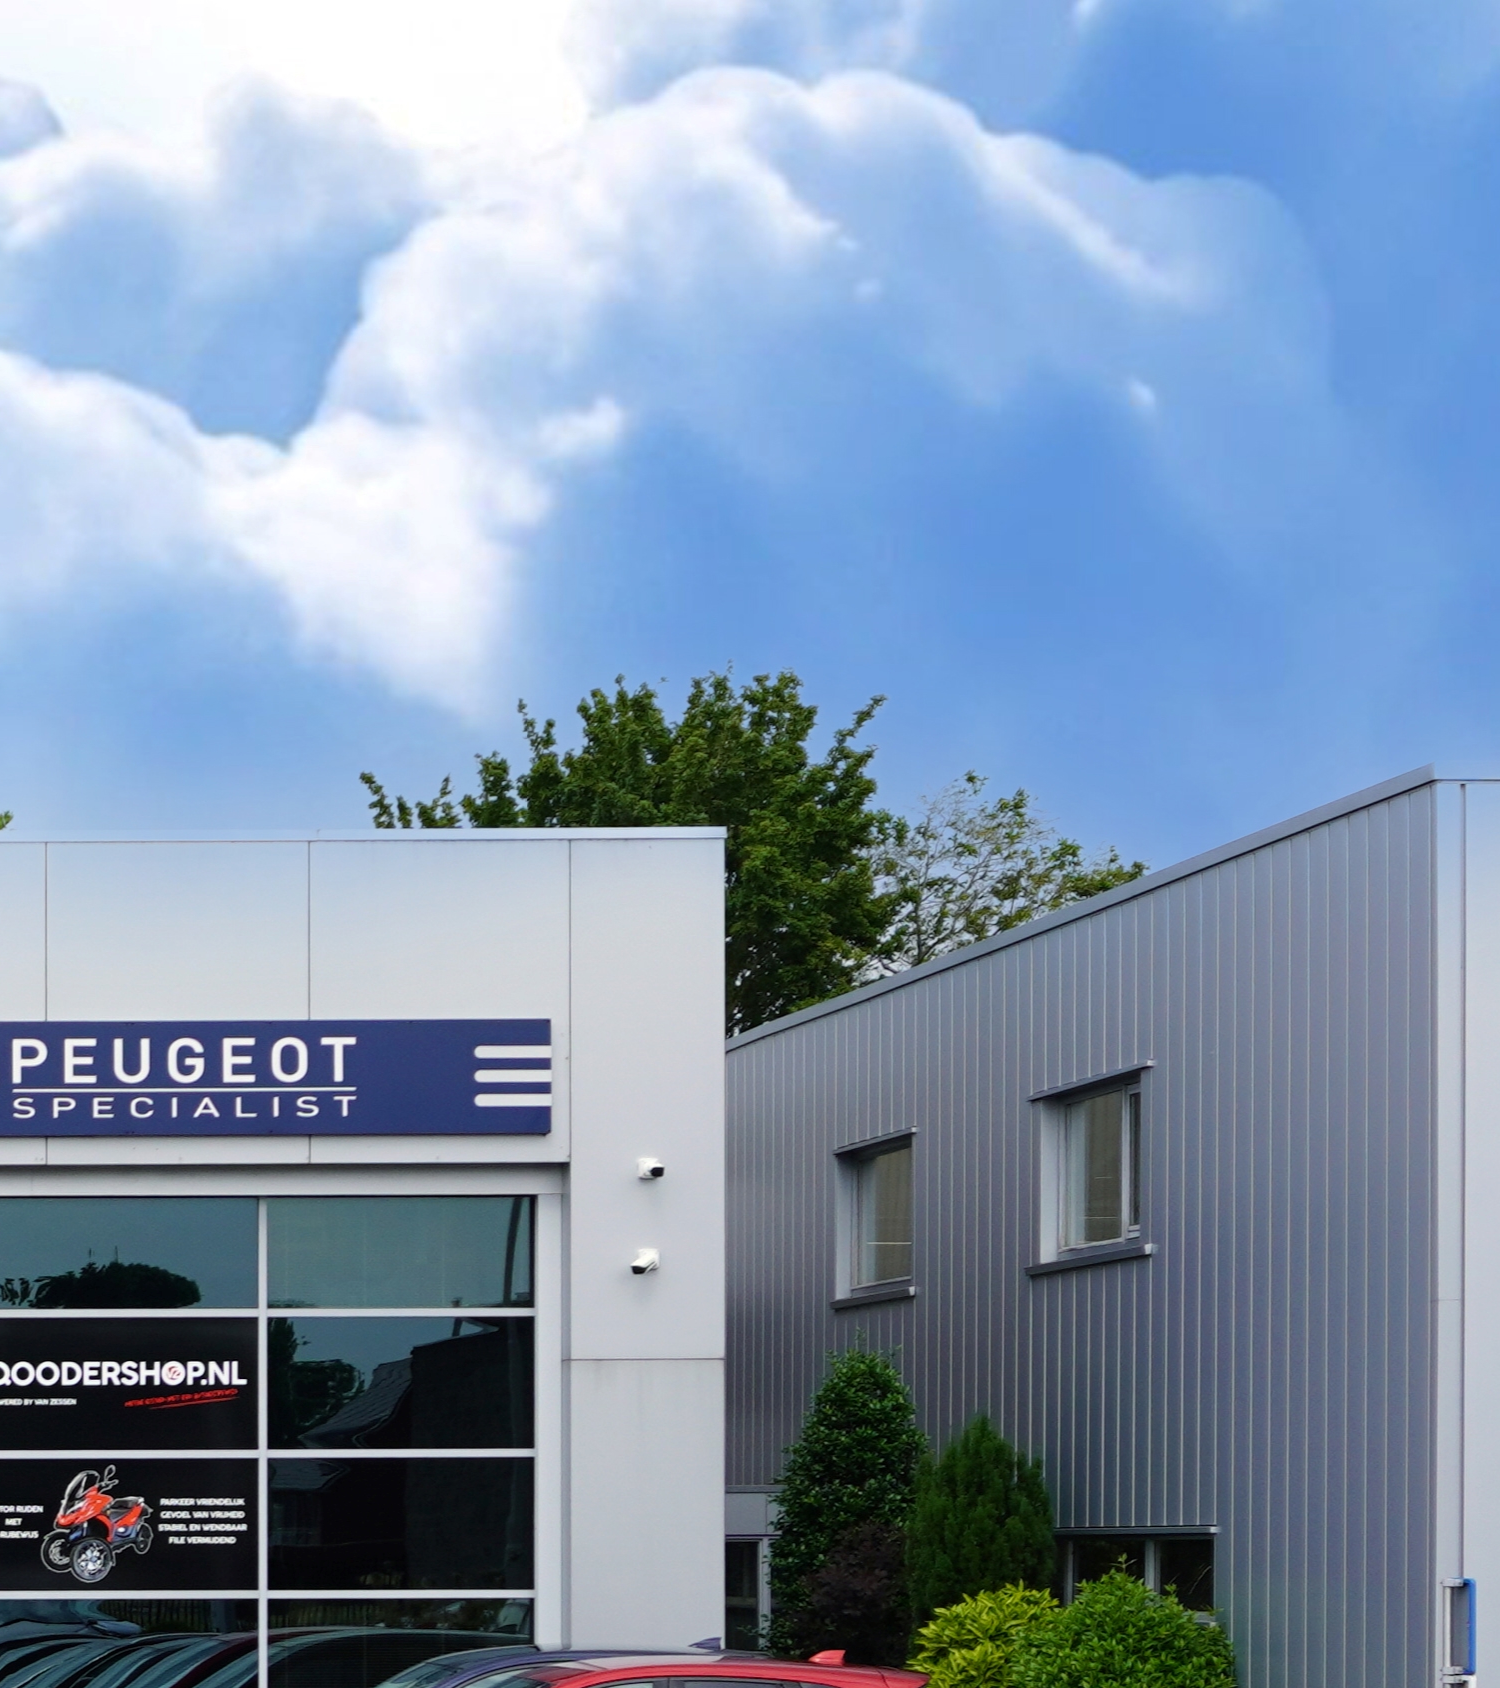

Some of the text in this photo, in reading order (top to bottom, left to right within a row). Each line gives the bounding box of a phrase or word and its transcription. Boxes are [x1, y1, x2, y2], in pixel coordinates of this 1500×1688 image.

[11, 1036, 357, 1084] PEUGEOT
[12, 1095, 357, 1119] SPECIALIST
[23, 1398, 34, 1406] BY
[34, 1398, 49, 1406] VAN
[49, 1398, 77, 1406] ZESSEN
[160, 1498, 195, 1506] PARKEER
[160, 1511, 192, 1519] GEVOEL
[193, 1511, 209, 1519] VAN
[4, 1517, 23, 1526] MET
[189, 1523, 201, 1532] EN
[202, 1523, 248, 1532] WENDBAAR
[168, 1536, 186, 1544] FILE
